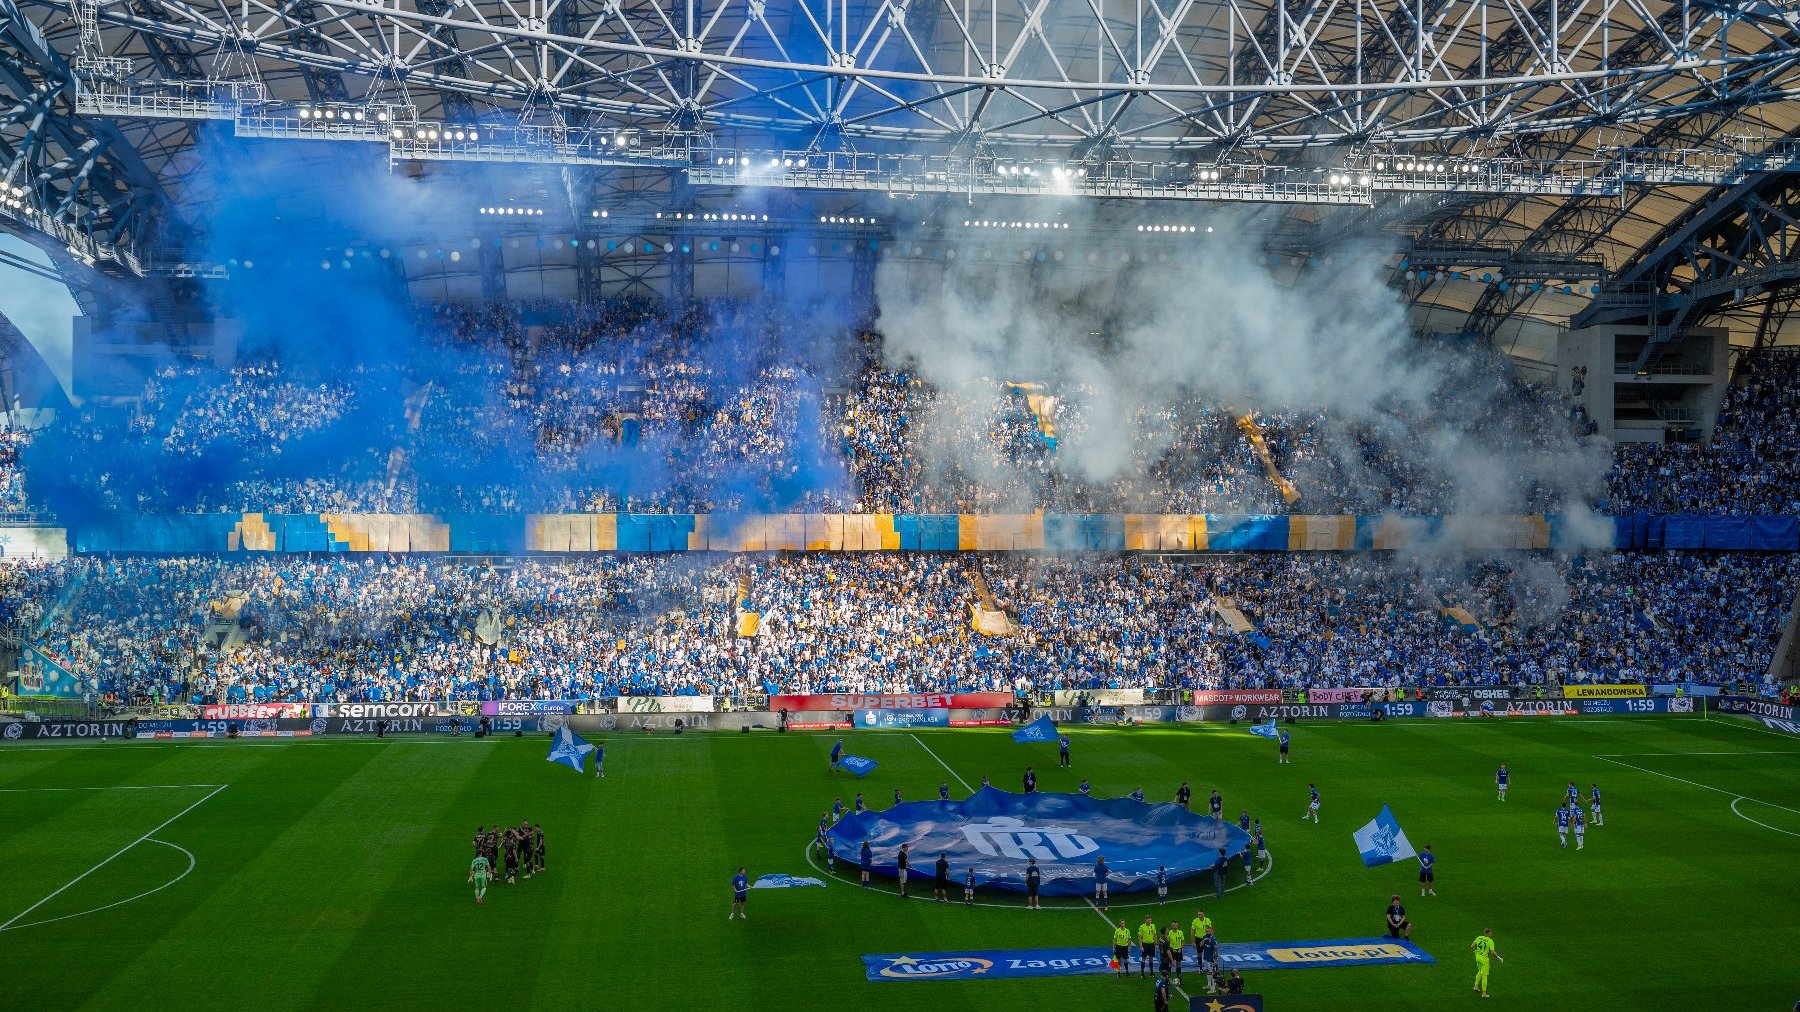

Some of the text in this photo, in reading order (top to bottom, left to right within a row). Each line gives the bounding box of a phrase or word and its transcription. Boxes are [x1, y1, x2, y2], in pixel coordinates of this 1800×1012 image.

[1235, 693, 1279, 701] WORKWEAR
[1312, 692, 1333, 701] BODY
[1474, 689, 1511, 699] OSHEE
[1576, 687, 1644, 697] LEWANDOWSKA
[831, 694, 955, 709] SUPERBET
[1507, 701, 1573, 711] AZTORIN
[1626, 699, 1655, 711] 1:59
[1259, 705, 1329, 717] AZTORIN
[1384, 703, 1414, 716] 1:59
[1745, 700, 1793, 719] ZTORIN
[37, 723, 124, 737] AZTORIN
[191, 721, 228, 733] 1:59
[341, 718, 423, 732] AZTRIN
[477, 862, 484, 871] 12
[1477, 940, 1487, 950] 41
[1219, 953, 1264, 962] na
[1292, 947, 1390, 959] lotto.pl
